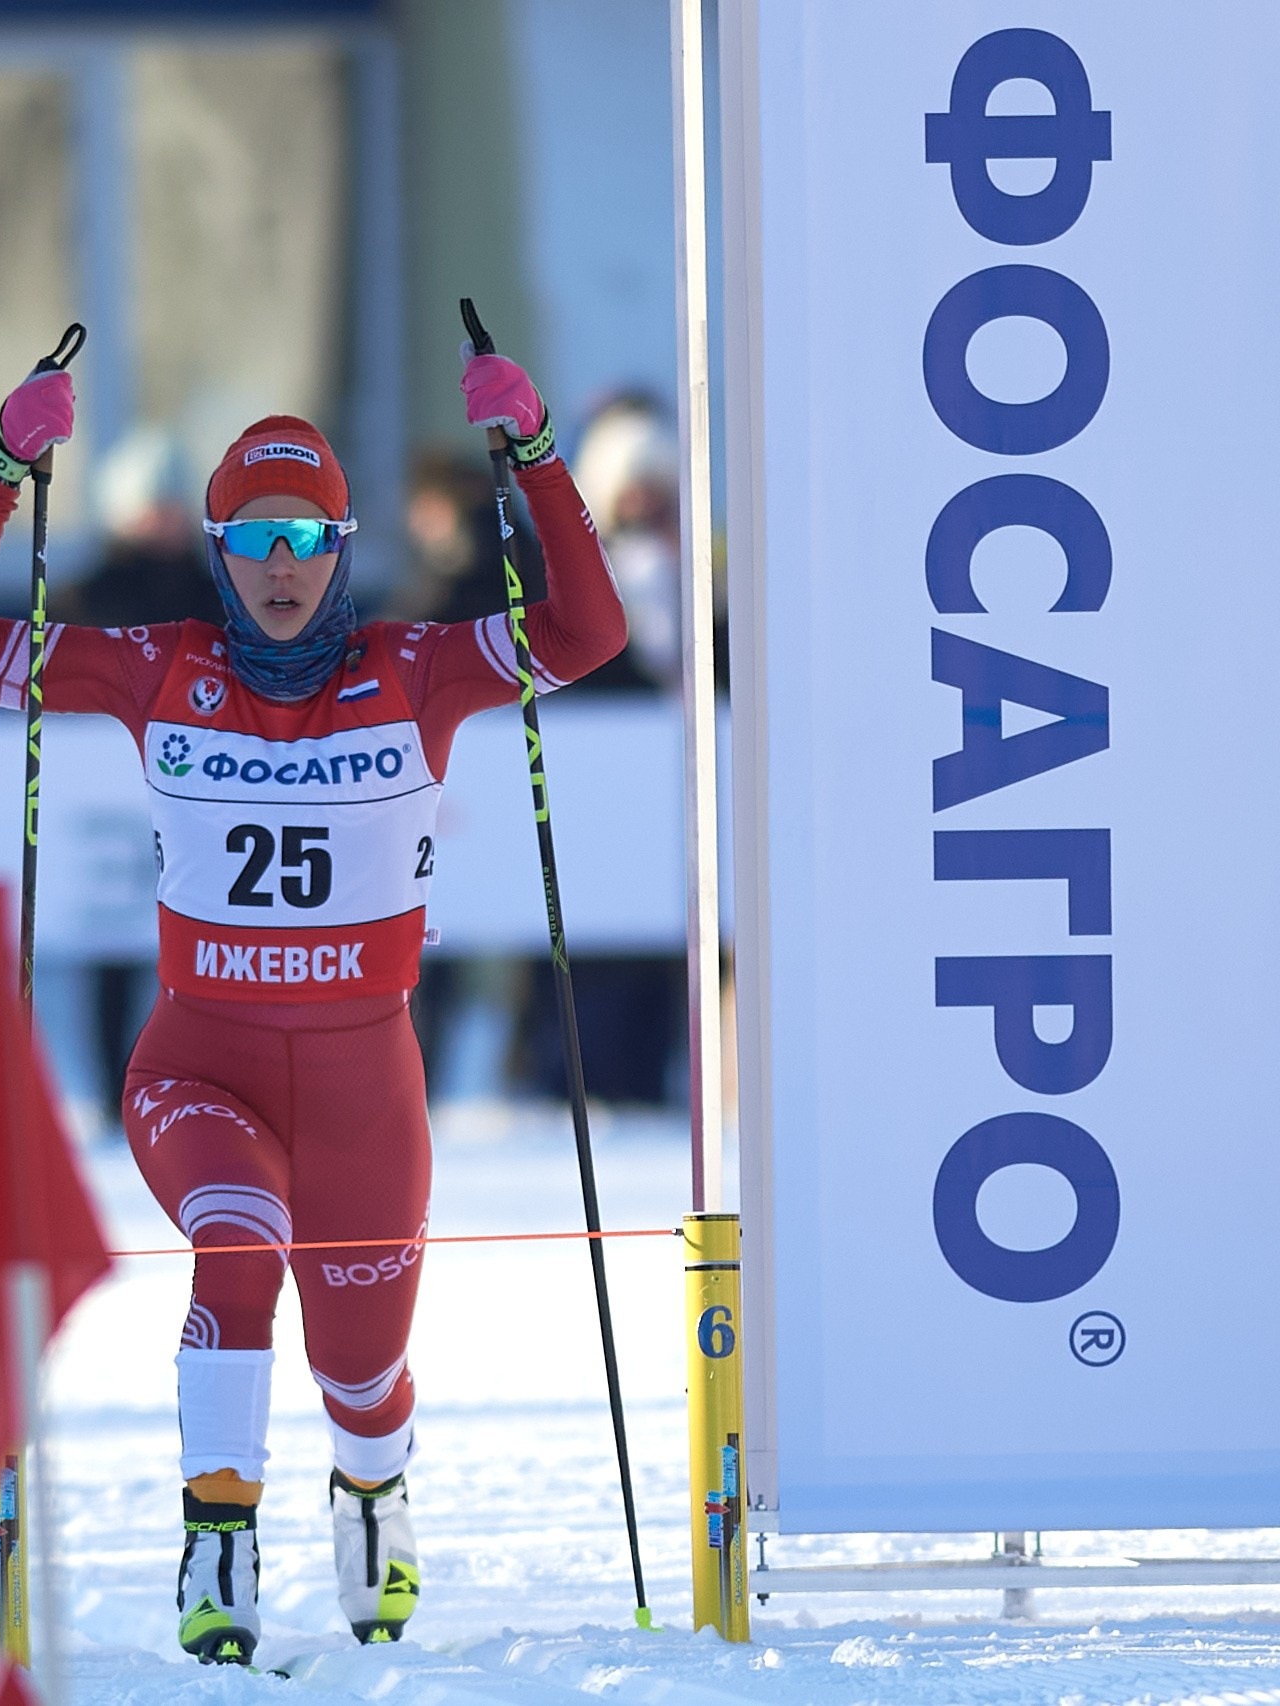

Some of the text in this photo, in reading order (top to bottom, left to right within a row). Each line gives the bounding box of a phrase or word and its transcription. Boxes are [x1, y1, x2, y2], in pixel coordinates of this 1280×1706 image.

[265, 446, 319, 463] LUKOIL
[226, 824, 334, 910] 25
[542, 865, 559, 939] BLACKCODE
[196, 940, 365, 984] ИЖЕВСК
[150, 1102, 258, 1148] LUKOIL
[697, 1305, 736, 1360] 6
